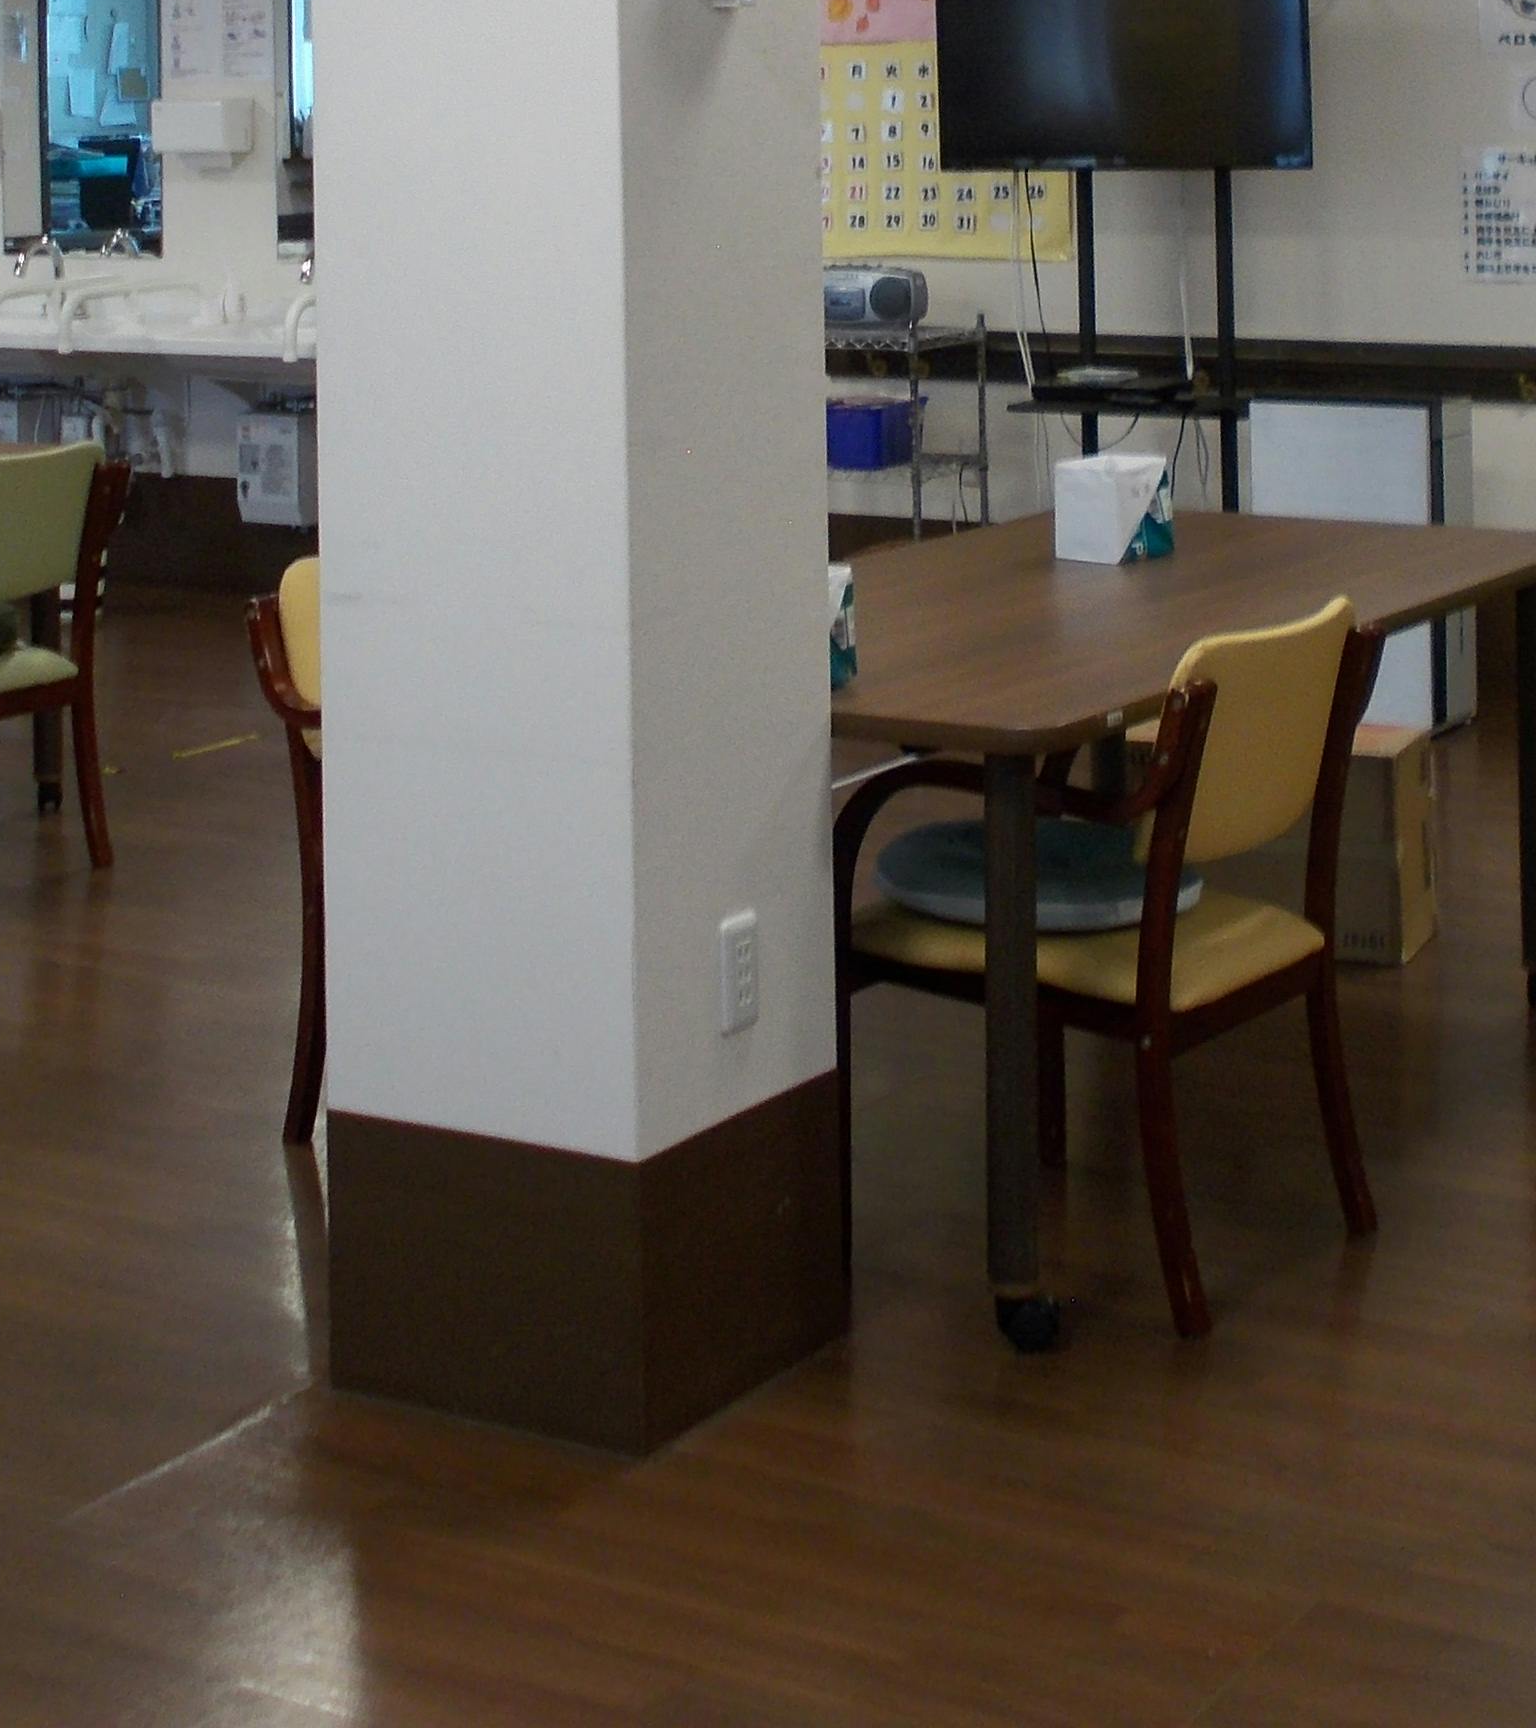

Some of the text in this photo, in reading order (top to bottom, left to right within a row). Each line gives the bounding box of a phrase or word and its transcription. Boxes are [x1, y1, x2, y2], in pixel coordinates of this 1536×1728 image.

[920, 94, 928, 108] 2
[888, 125, 896, 138] 8
[886, 154, 901, 168] 15
[849, 186, 864, 200] 21
[885, 186, 901, 200] 22
[921, 188, 937, 202] 23
[993, 186, 1010, 200] 25
[849, 215, 865, 229] 28
[921, 213, 936, 228] 30
